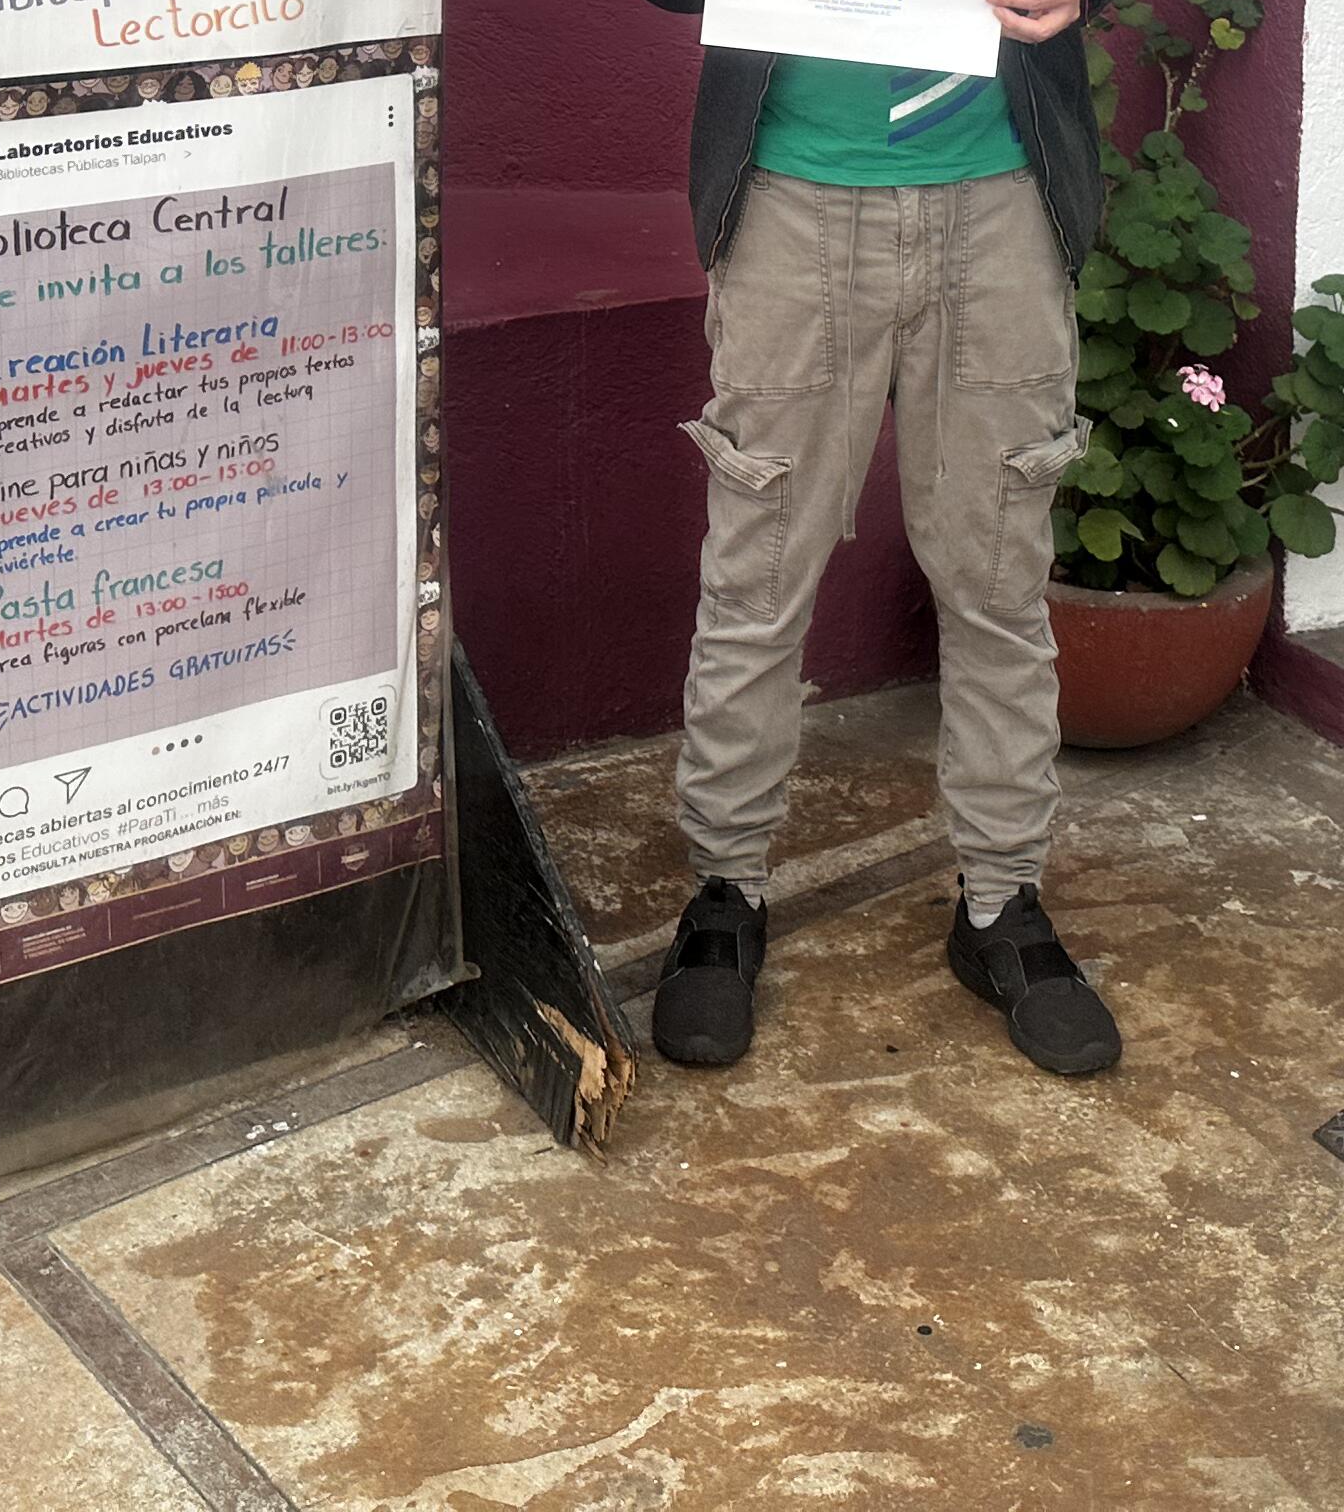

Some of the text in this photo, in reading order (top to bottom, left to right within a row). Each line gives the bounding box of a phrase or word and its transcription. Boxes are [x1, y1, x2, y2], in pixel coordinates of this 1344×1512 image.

[152, 185, 288, 234] Central
[37, 262, 141, 302] invita
[160, 262, 184, 285] a
[205, 248, 246, 277] los
[258, 226, 388, 269] talleres:
[142, 315, 280, 357] Literaria
[91, 558, 224, 606] francesa
